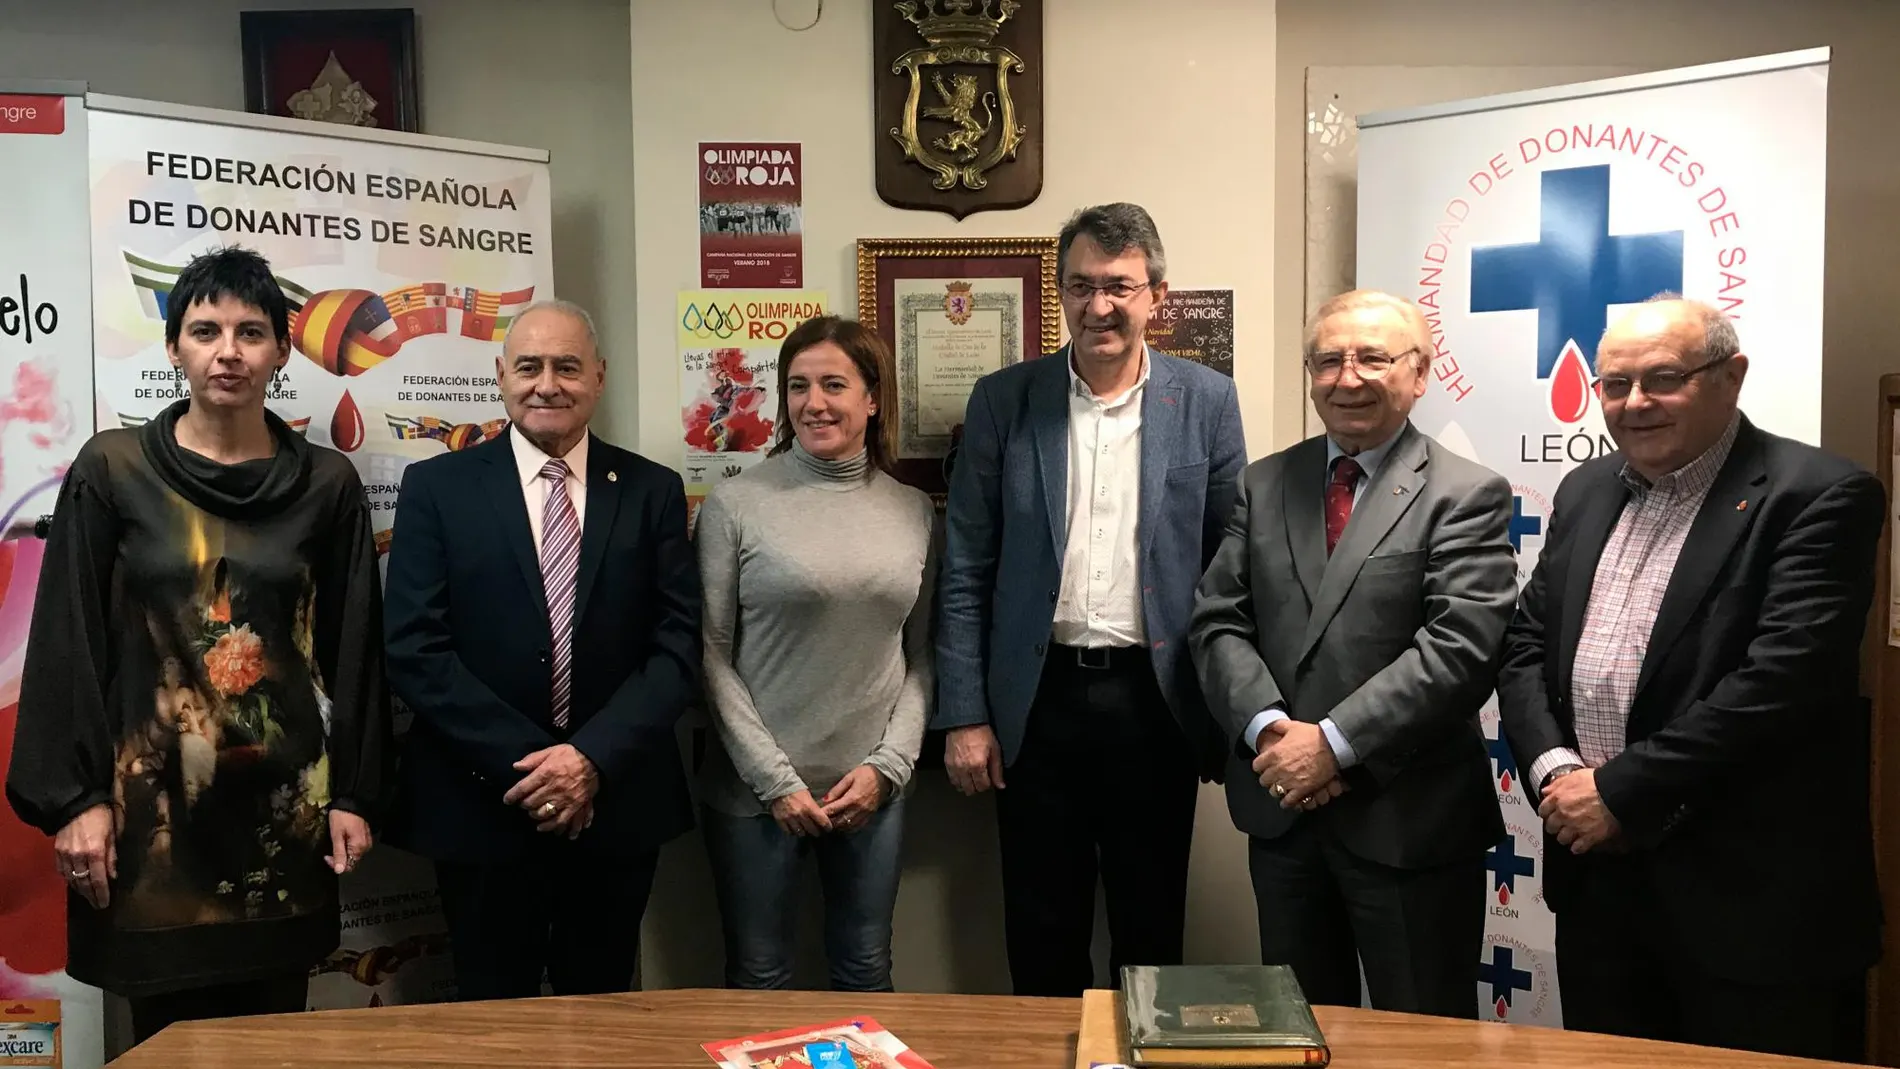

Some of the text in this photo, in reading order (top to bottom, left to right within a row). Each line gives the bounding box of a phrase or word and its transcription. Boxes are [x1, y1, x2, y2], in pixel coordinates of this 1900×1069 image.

[704, 149, 794, 164] OLIMPIADA
[147, 151, 517, 211] FEDERACIÓN ESPAÑOLA
[736, 166, 795, 185] ROJA
[1468, 153, 1514, 196] DE
[1519, 124, 1705, 188] DONANTES
[1697, 187, 1740, 237] DE
[129, 199, 533, 254] DE DONANTES DE SANGRE
[1217, 297, 1226, 305] DE
[746, 302, 823, 319] OLIMPIADA
[1162, 308, 1178, 319] DE
[1183, 307, 1226, 320] SANGRE
[748, 321, 801, 339] RO
[403, 375, 468, 386] FEDERACIÓN
[135, 389, 152, 398] DE
[398, 392, 412, 401] DE
[416, 392, 471, 402] DONANTES
[473, 393, 487, 402] DE
[1489, 905, 1519, 919] LEÓN
